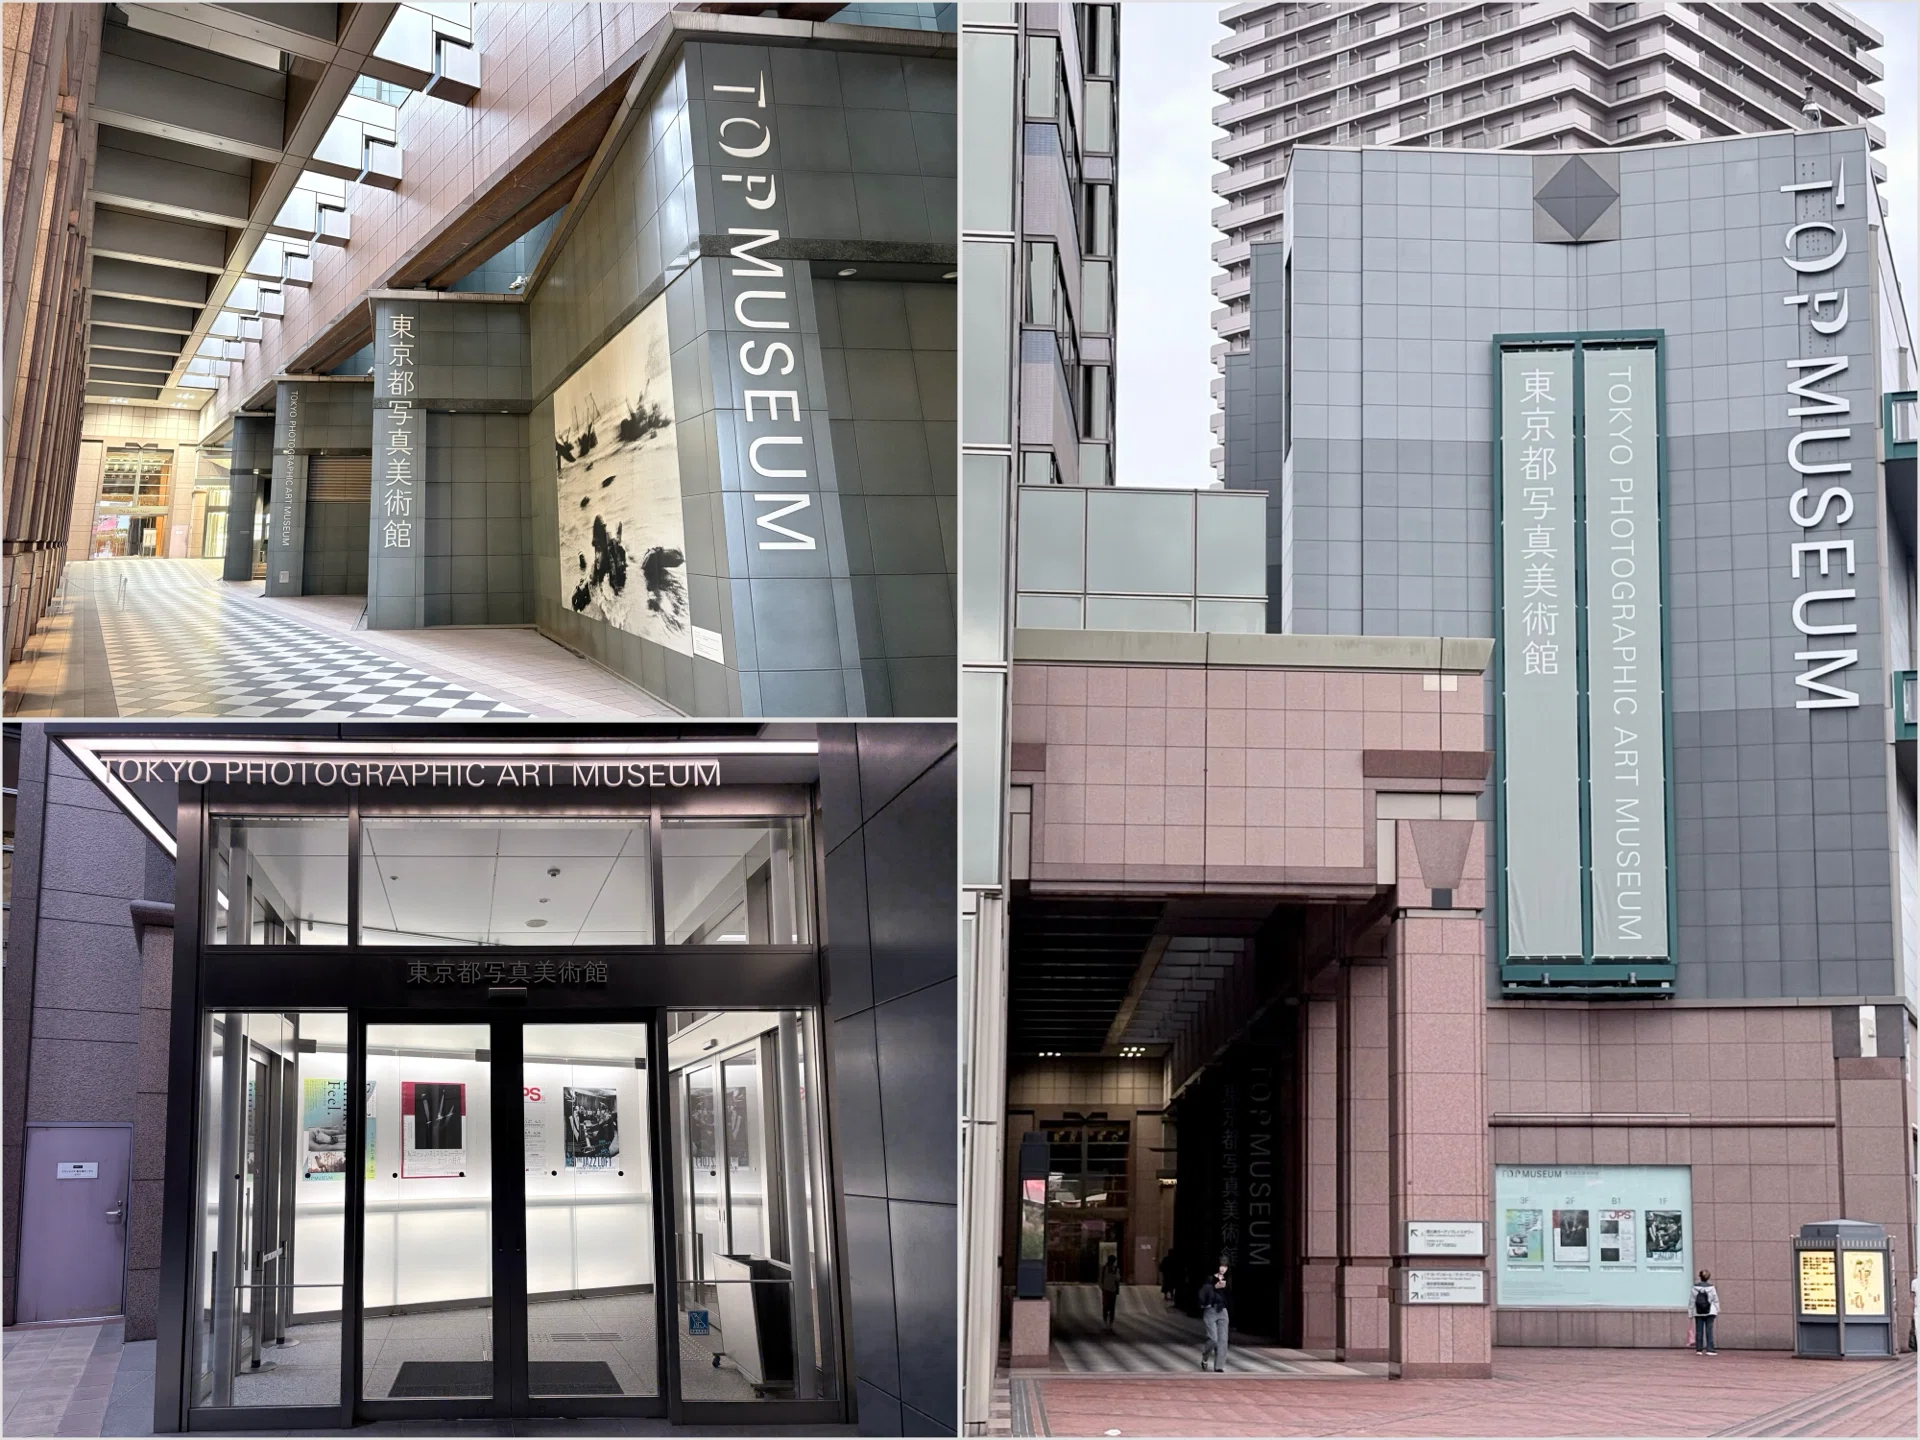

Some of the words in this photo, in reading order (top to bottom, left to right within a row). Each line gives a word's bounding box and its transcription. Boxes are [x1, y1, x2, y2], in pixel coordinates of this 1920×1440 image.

[712, 69, 778, 210] TOP
[1780, 156, 1849, 334] TOP
[289, 390, 299, 418] TOKYO
[727, 227, 817, 551] MUSEUM
[1608, 365, 1633, 465] TOKYO
[285, 420, 297, 487] PHOTOGRAPHIC
[382, 313, 416, 549] 東京都写真美術館
[281, 505, 292, 547] MUSEUM
[284, 486, 293, 504] ART
[1519, 368, 1559, 676] 東京都写真美術館
[1786, 355, 1860, 709] MUSEUM
[1609, 477, 1638, 716] PHOTOGRAPHIC
[101, 758, 212, 784] TOKYO
[225, 759, 486, 788] PHOTOGRAPHIC
[497, 761, 560, 788] ART
[572, 761, 721, 788] MUSEUM
[1613, 725, 1639, 786] ART
[1615, 798, 1642, 941] MUSEUM
[406, 960, 609, 985] 東京都写真美術館
[327, 1081, 341, 1116] Feel.
[1249, 1133, 1272, 1266] MUSEUM
[1522, 1169, 1562, 1178] MUSEUM
[1609, 1210, 1632, 1220] JPS
